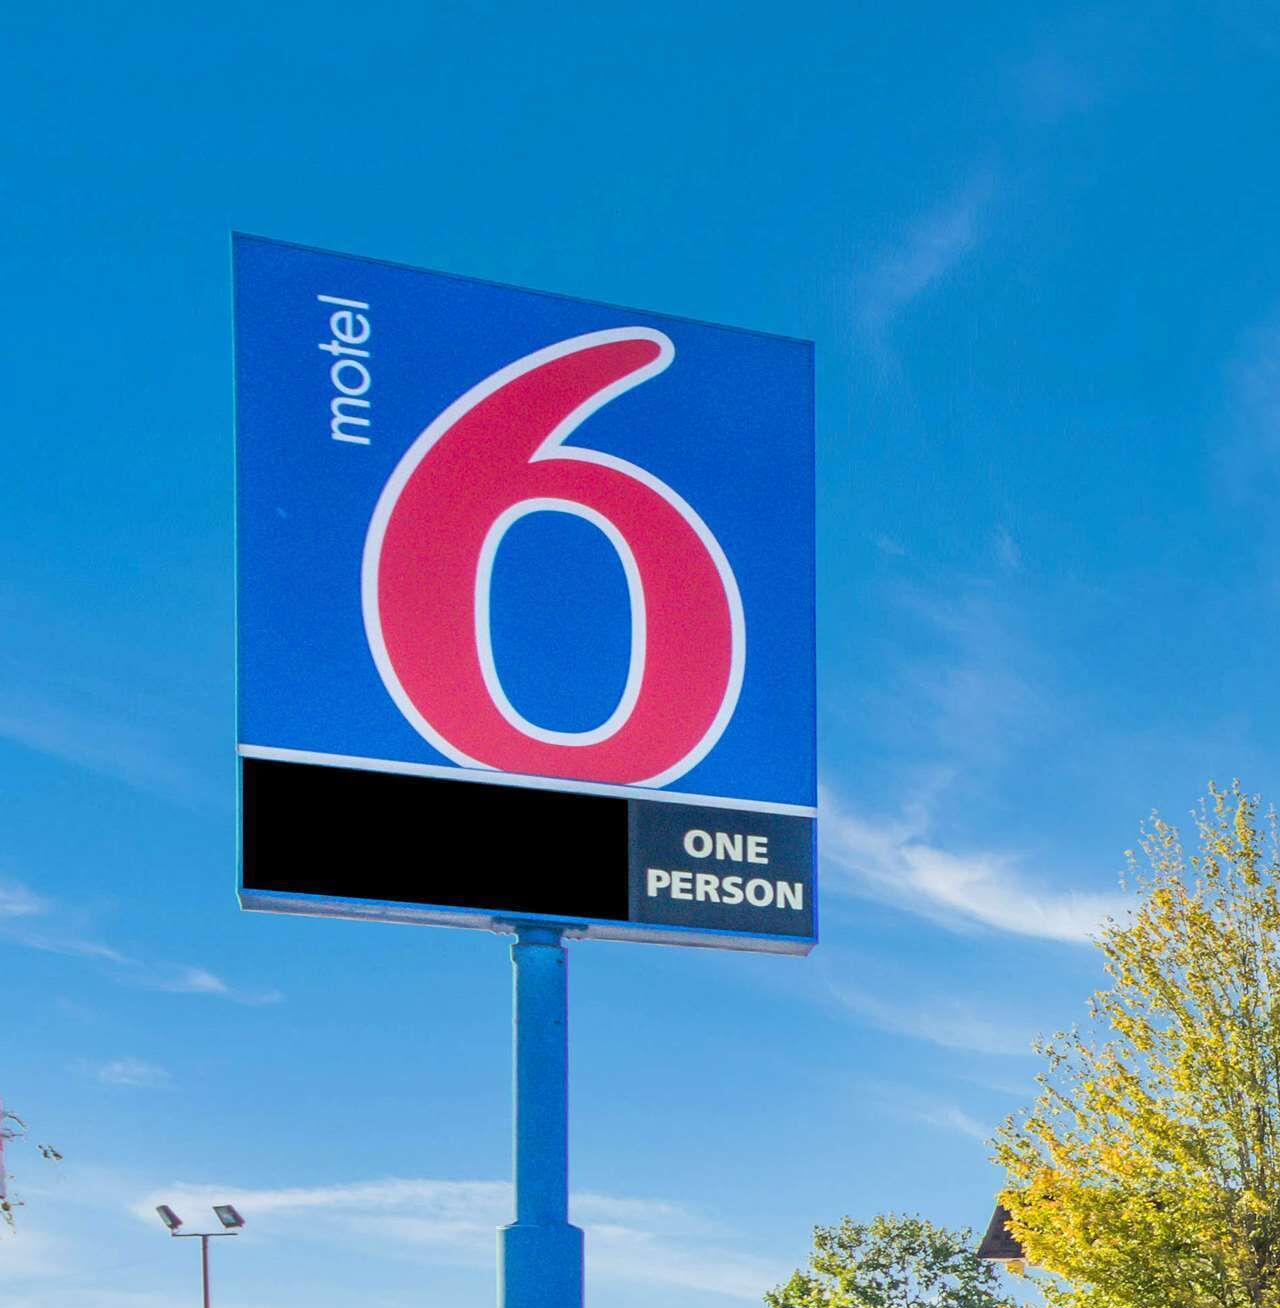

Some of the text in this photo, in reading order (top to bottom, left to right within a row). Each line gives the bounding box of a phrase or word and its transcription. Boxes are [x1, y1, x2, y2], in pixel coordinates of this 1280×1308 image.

[317, 294, 371, 445] motel
[361, 326, 746, 788] 6
[646, 868, 804, 911] PERSON
[683, 829, 769, 865] ONE
